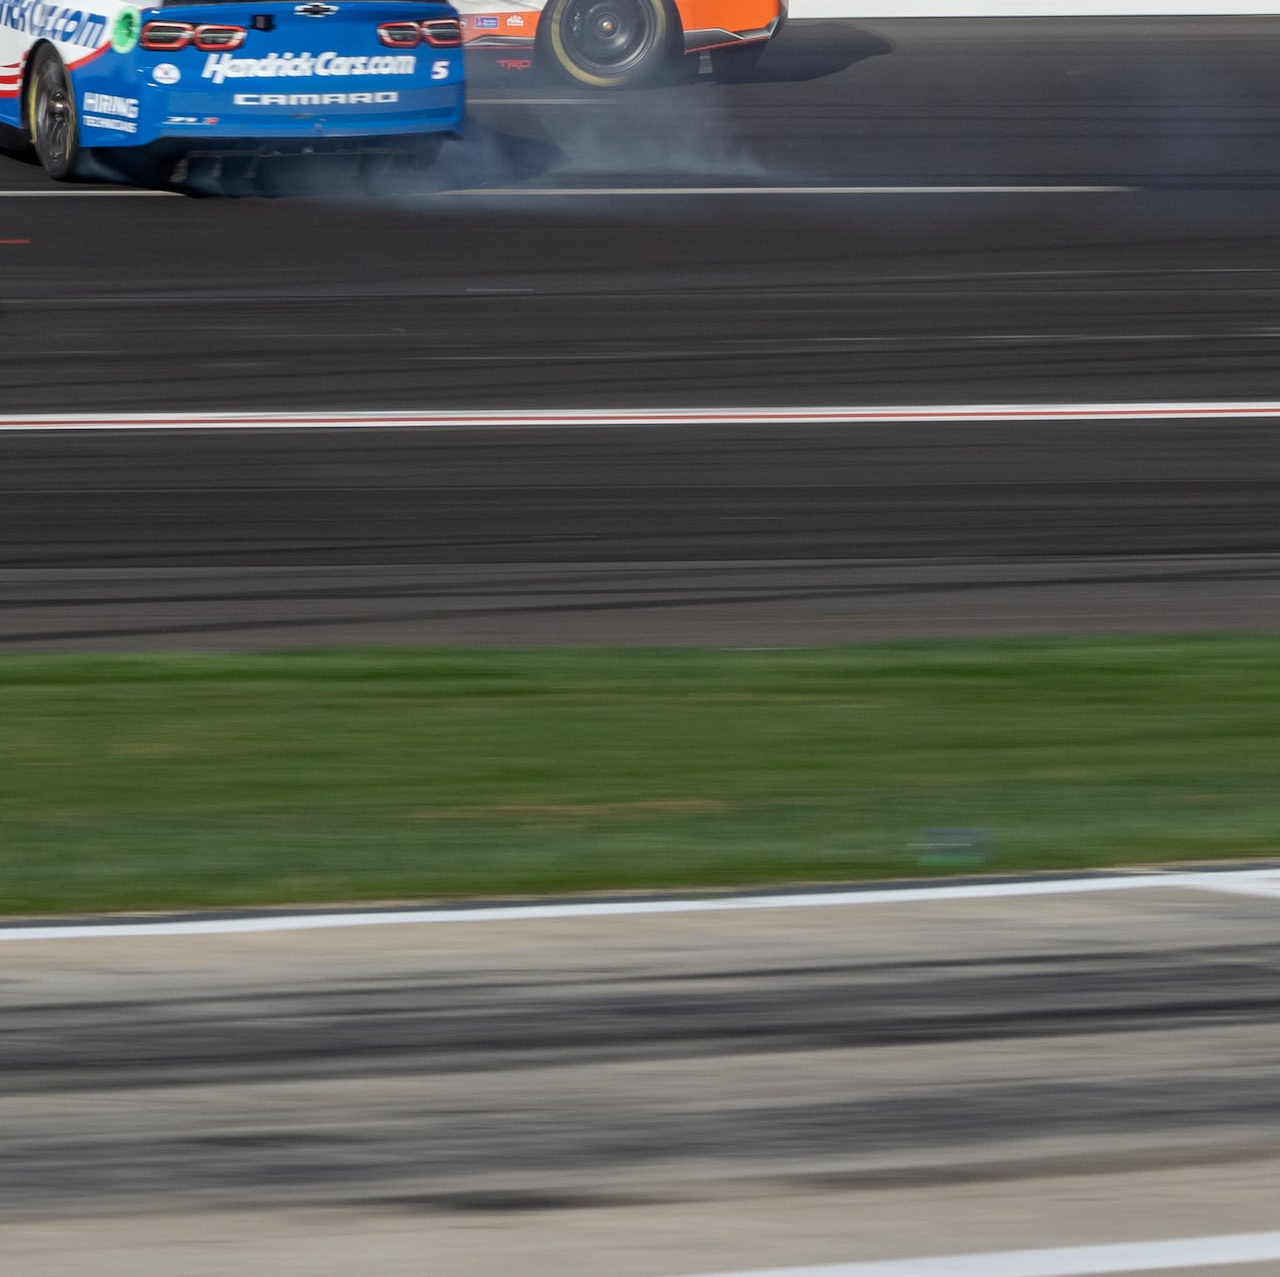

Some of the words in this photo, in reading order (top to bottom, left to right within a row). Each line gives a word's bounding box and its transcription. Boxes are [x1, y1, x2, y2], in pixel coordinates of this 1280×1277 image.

[430, 60, 451, 80] 5
[496, 59, 532, 71] TRD
[83, 91, 139, 119] HIRING
[233, 91, 399, 105] CAMARO
